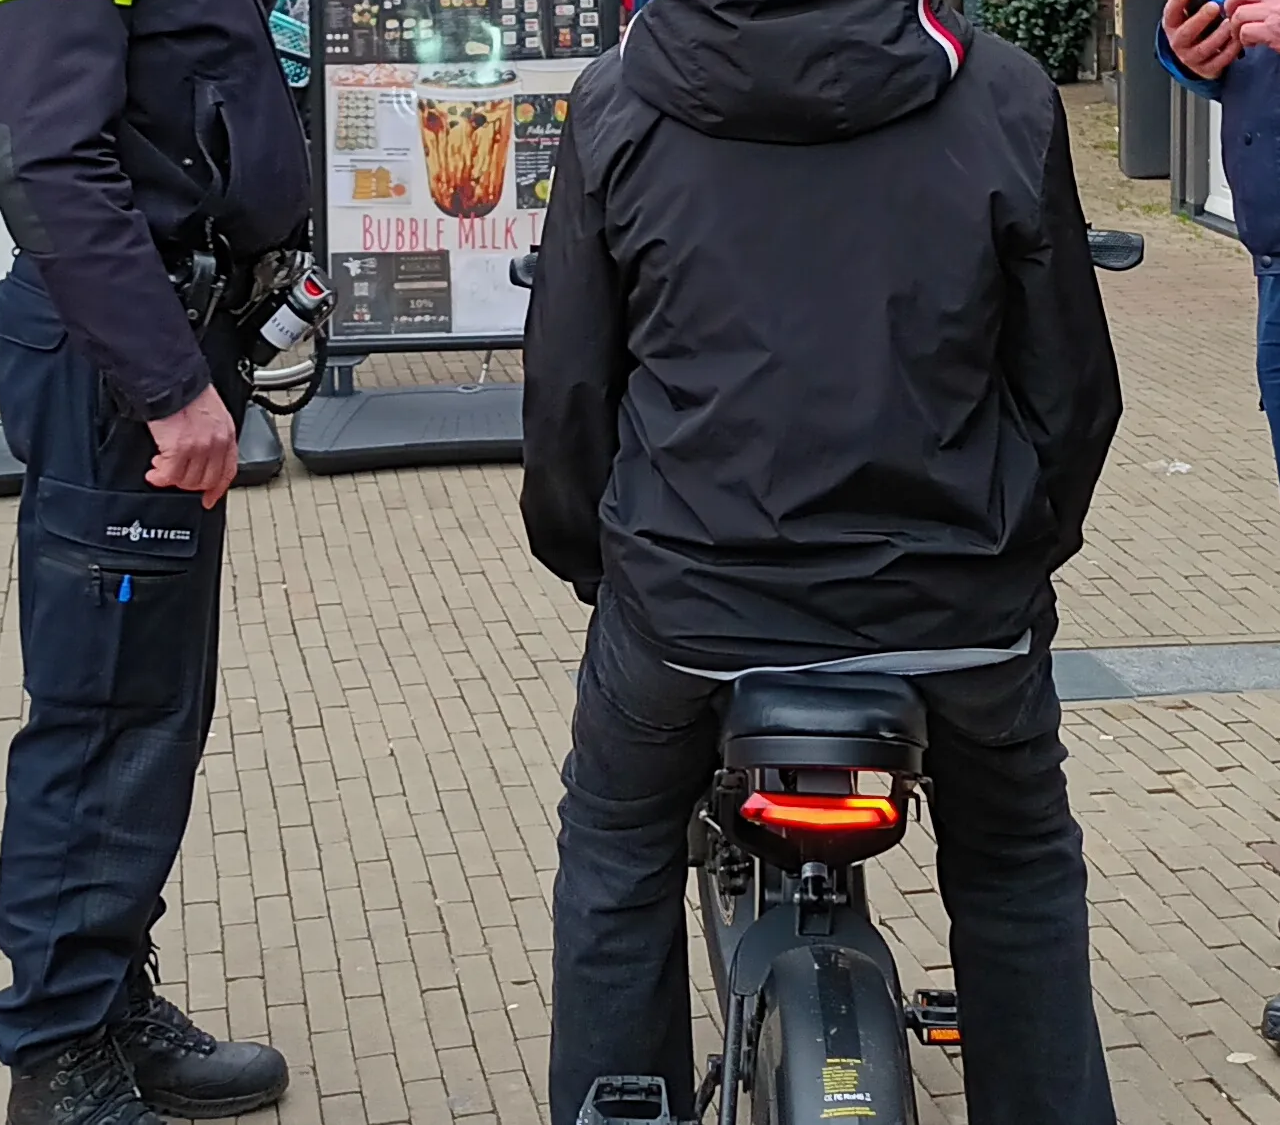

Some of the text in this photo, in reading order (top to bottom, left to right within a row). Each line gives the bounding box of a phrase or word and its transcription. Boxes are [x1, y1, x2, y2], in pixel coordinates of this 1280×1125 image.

[362, 214, 446, 251] BUBBLE
[458, 212, 518, 250] MILK
[122, 525, 177, 541] POLITIE
